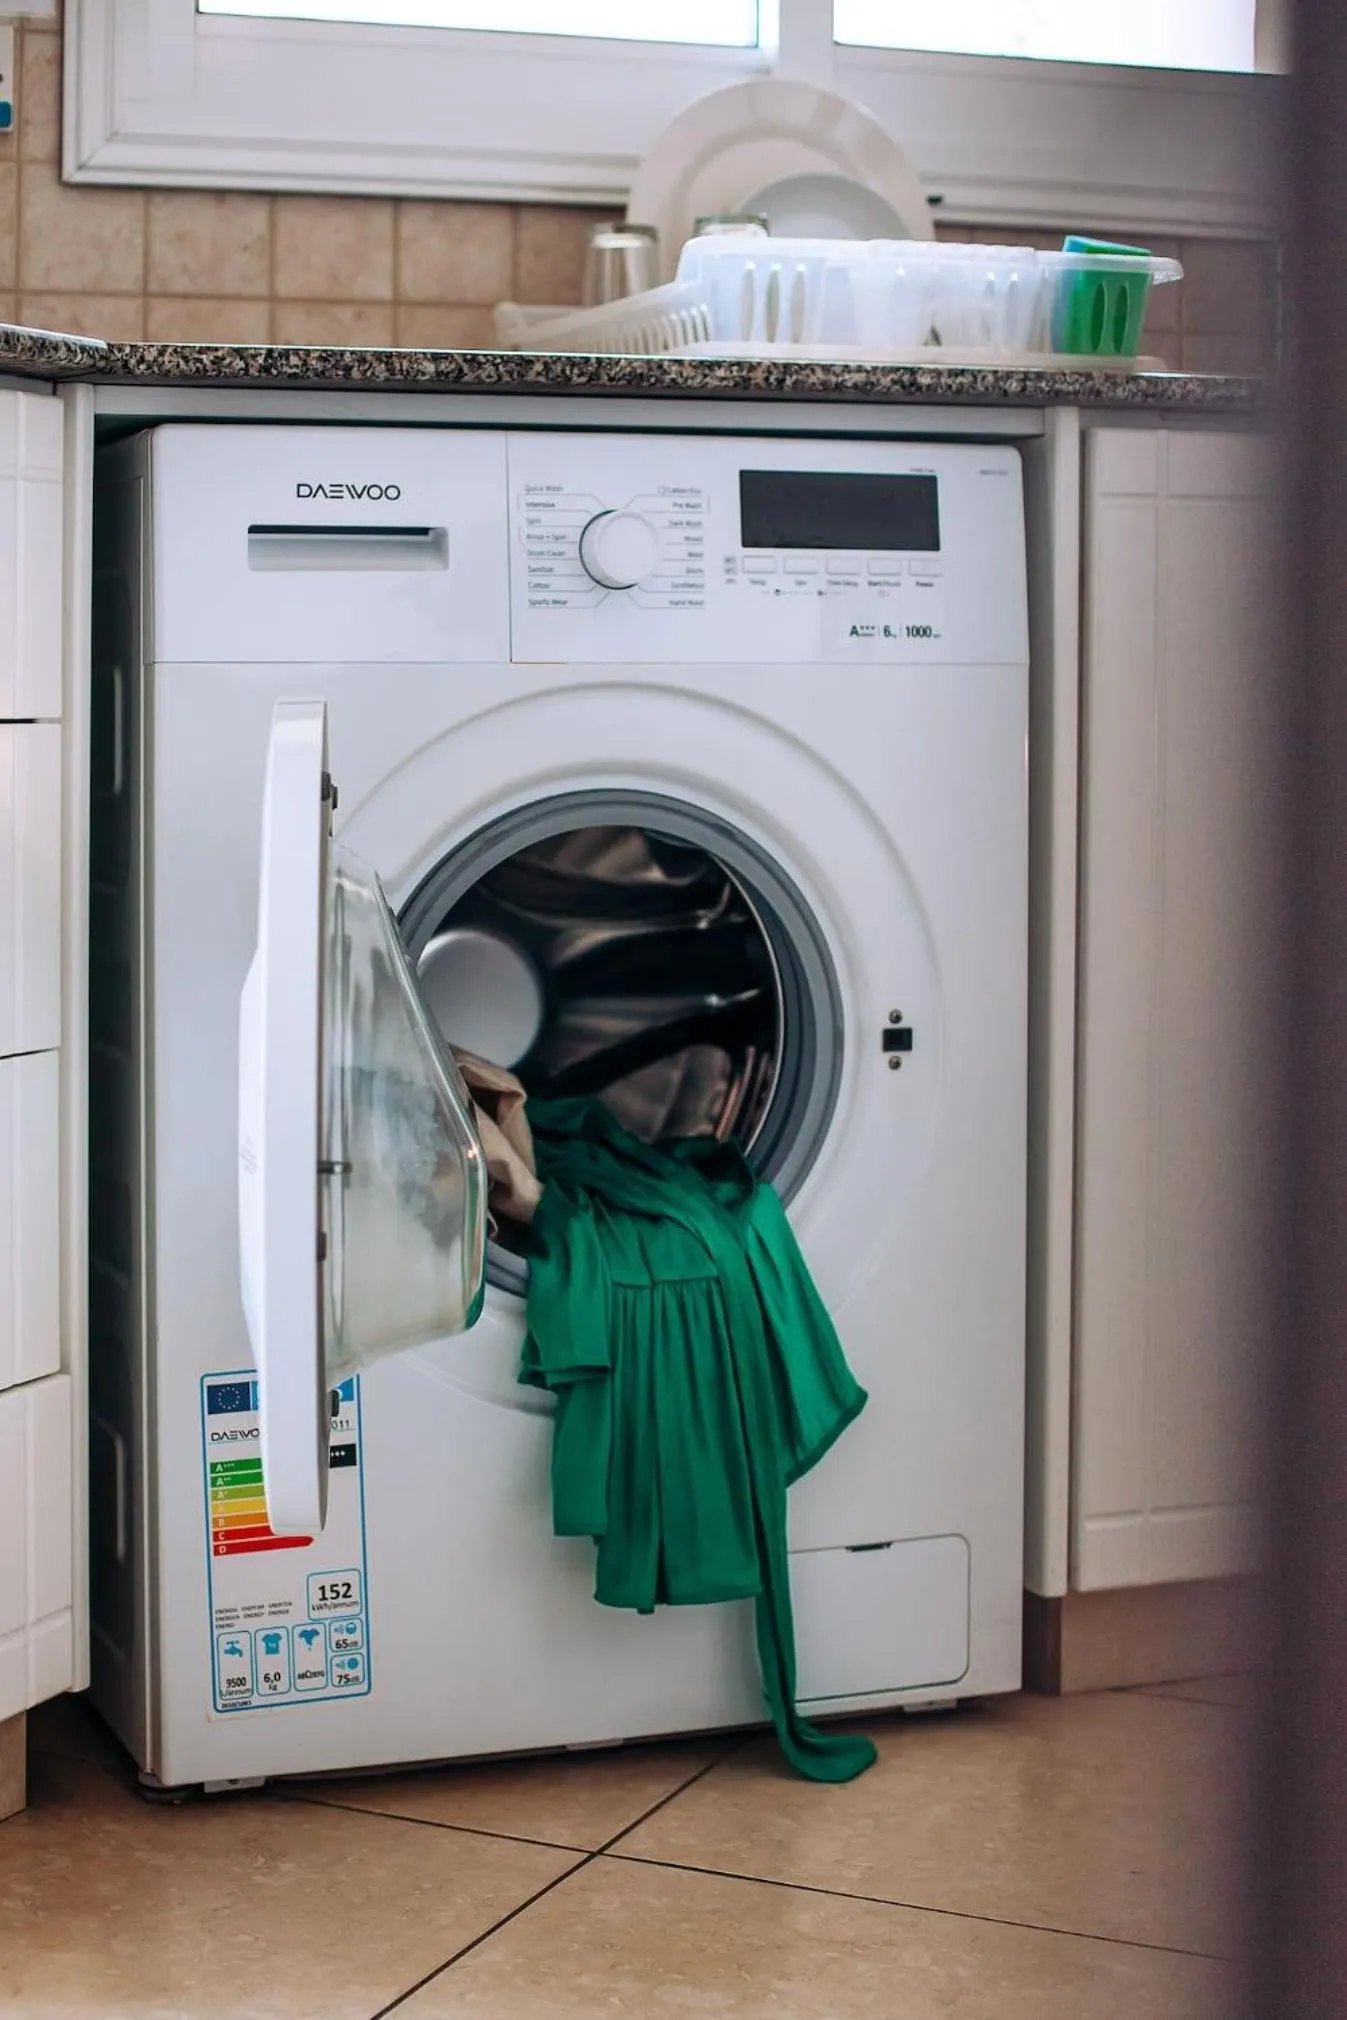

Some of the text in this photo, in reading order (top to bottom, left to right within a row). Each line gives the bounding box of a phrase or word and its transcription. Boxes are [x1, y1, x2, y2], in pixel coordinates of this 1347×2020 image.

[296, 483, 400, 500] DAEWOO
[331, 1419, 350, 1429] 011
[210, 1428, 260, 1442] DAEWO
[318, 1582, 352, 1602] 152
[226, 1677, 247, 1689] 9500
[263, 1671, 281, 1684] 6,0
